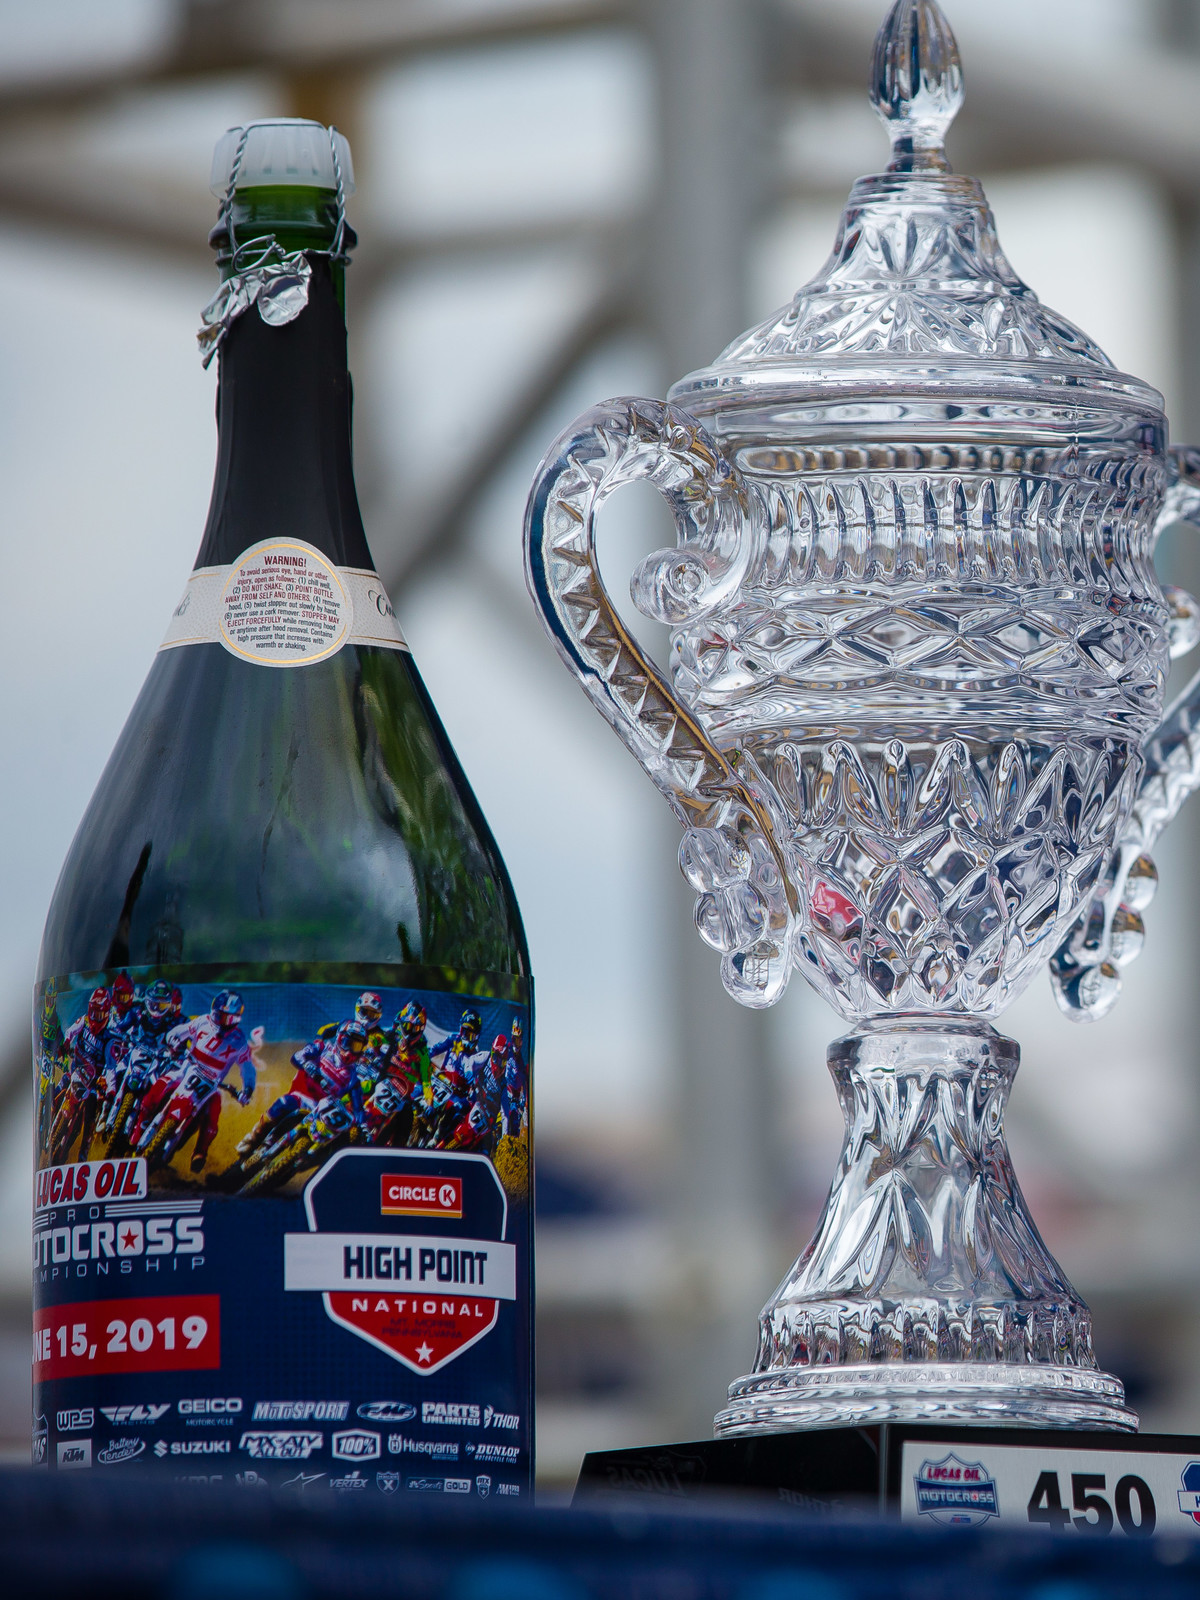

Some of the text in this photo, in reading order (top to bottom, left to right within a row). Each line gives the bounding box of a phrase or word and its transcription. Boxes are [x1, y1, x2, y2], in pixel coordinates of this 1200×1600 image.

[264, 556, 306, 567] WARNING!
[275, 574, 296, 583] follows:
[298, 577, 306, 585] (1)
[314, 572, 327, 580] other
[233, 586, 241, 595] (2)
[242, 585, 250, 593] DO
[251, 584, 262, 592] NOT
[285, 584, 294, 592] (3)
[295, 585, 312, 593] POINT
[314, 588, 333, 598] BOTTLE
[225, 595, 240, 603] AWAY
[241, 593, 257, 601] FROM
[273, 591, 286, 599] AND
[312, 595, 321, 603] (4)
[322, 599, 341, 608] remove
[244, 601, 252, 610] (5)
[268, 600, 288, 608] stopper
[298, 602, 315, 612] slowly
[316, 604, 323, 612] by
[224, 612, 232, 620] (6)
[301, 610, 327, 620] STOPPER
[328, 615, 340, 624] MAY
[227, 619, 244, 628] EJECT
[245, 616, 281, 626] FORCEFULLY
[297, 618, 322, 629] removing
[323, 621, 336, 631] hood
[236, 626, 257, 634] anytime
[272, 624, 286, 632] hood
[310, 627, 333, 638] Contains
[237, 632, 324, 645] high pressure that increases with
[256, 641, 276, 649] warmth
[36, 1161, 140, 1208] LUCAS OIL
[388, 1184, 456, 1207] CIRCLE K
[50, 1206, 100, 1225] PRO
[343, 1245, 488, 1285] HIGH POINT
[351, 1298, 484, 1317] NATIONAL
[32, 1315, 208, 1365] NE 15, 2019
[100, 1404, 171, 1422] FLY
[178, 1398, 243, 1414] GEICO
[422, 1402, 480, 1419] PARTS
[57, 1408, 94, 1431] WPS
[186, 1418, 234, 1426] MOTORCYCLE
[422, 1415, 480, 1426] UNLIMITED
[493, 1413, 520, 1430] THOR
[109, 1437, 139, 1452] Battery
[170, 1440, 231, 1454] SUZUKI
[339, 1437, 374, 1454] 100%
[403, 1439, 459, 1455] Husqvarna
[476, 1444, 520, 1457] DUNLOP
[63, 1447, 86, 1463] KTM
[101, 1448, 134, 1463] Tender
[928, 1467, 981, 1481] LUCAS OIL
[330, 1479, 369, 1488] VERTEX
[446, 1482, 469, 1491] GOLD
[919, 1491, 994, 1503] MOTOCROSS
[1026, 1470, 1157, 1539] 450
